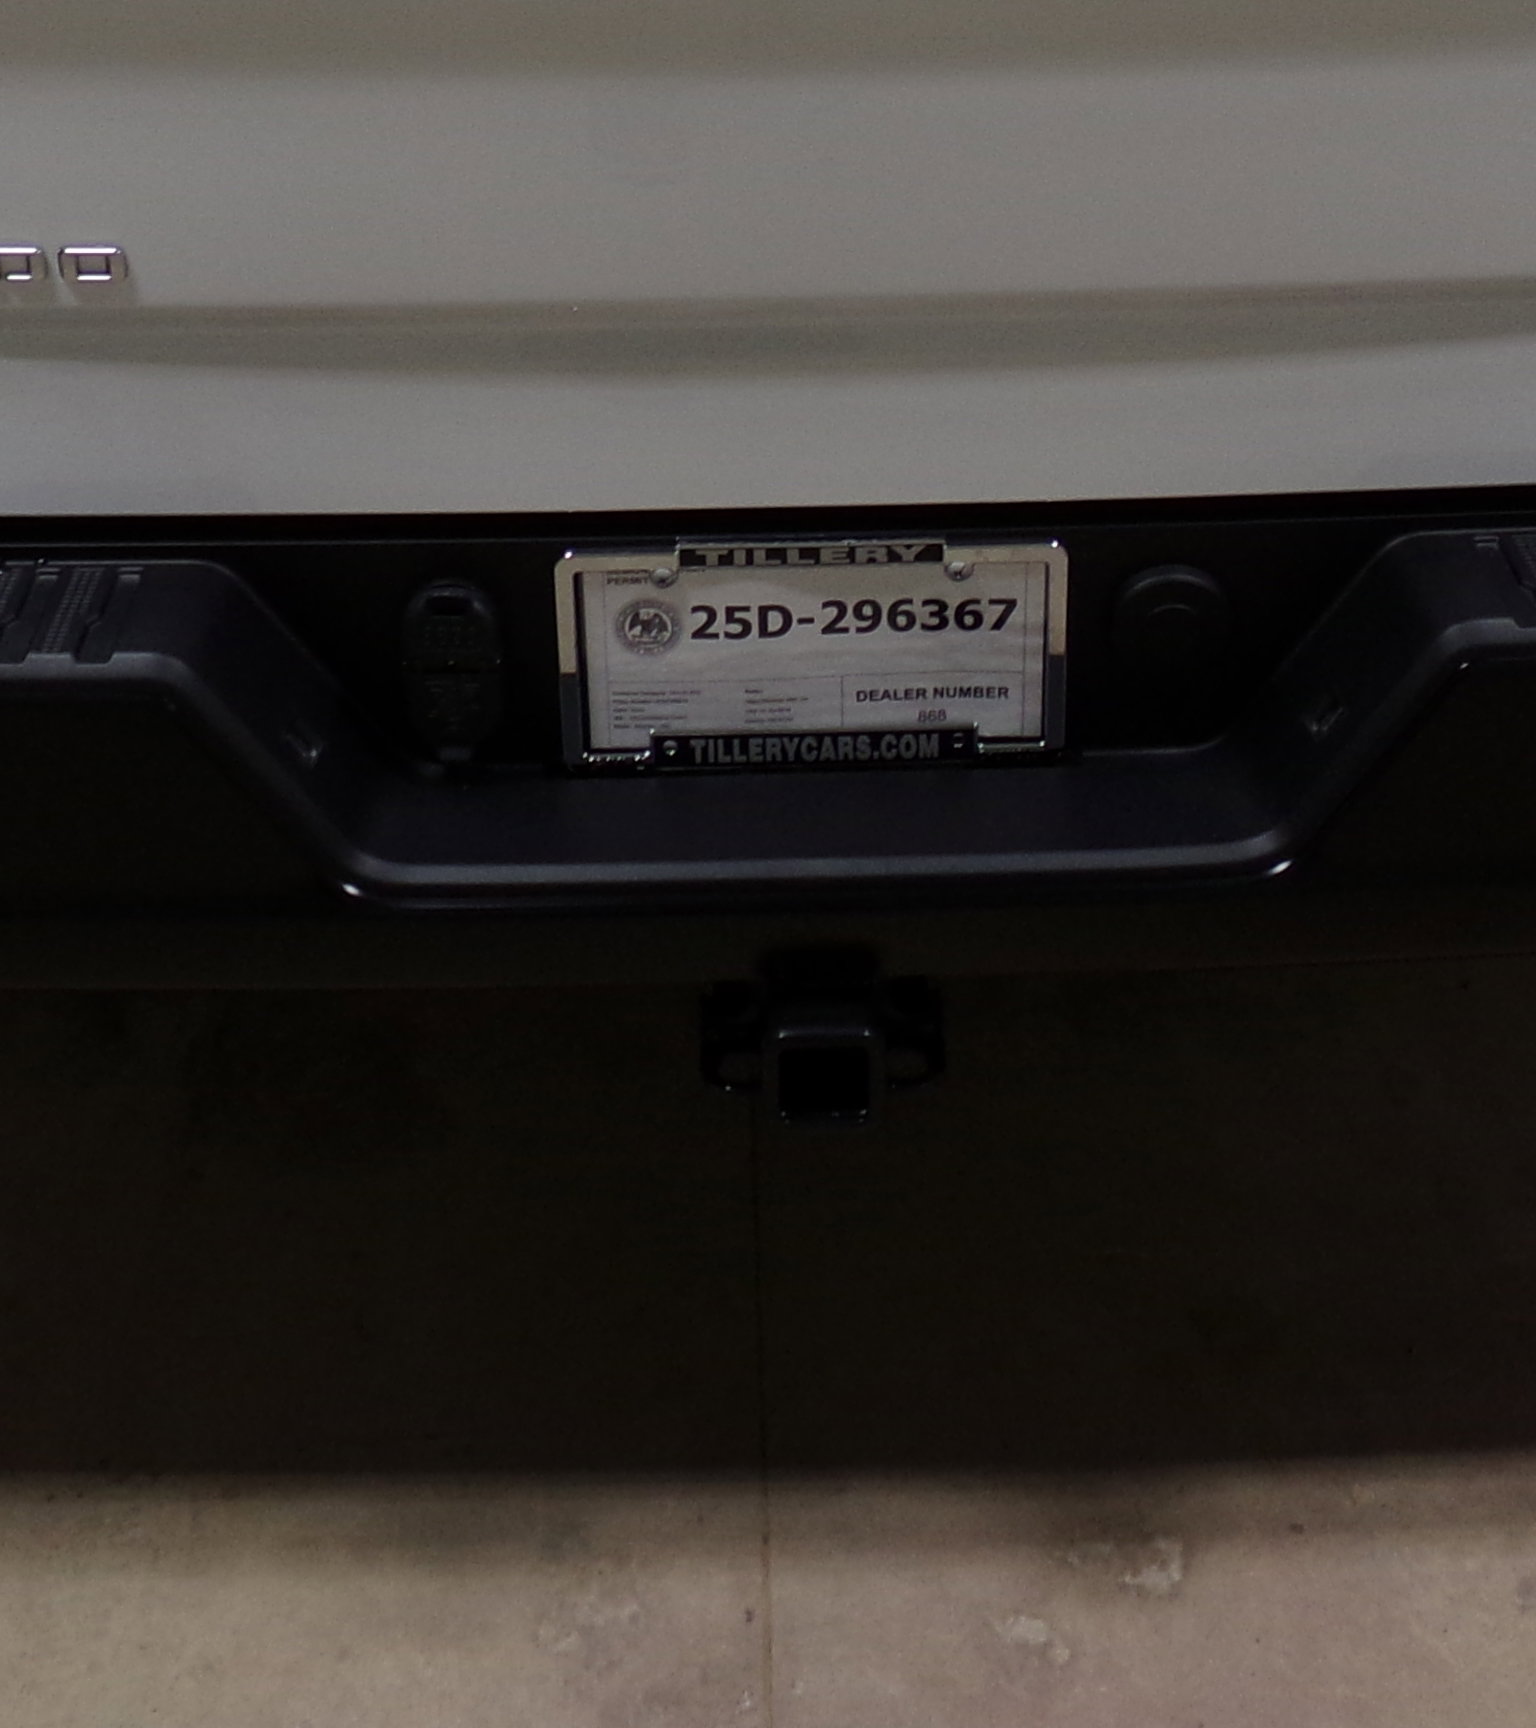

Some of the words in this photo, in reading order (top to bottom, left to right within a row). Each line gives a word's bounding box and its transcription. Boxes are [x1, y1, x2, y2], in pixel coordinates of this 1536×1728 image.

[694, 547, 928, 566] TILLERY
[689, 597, 1019, 641] 25D-296367
[856, 687, 927, 702] DEALER
[933, 685, 1010, 699] NUMBER
[689, 733, 940, 763] TILLERYCARS.COM
